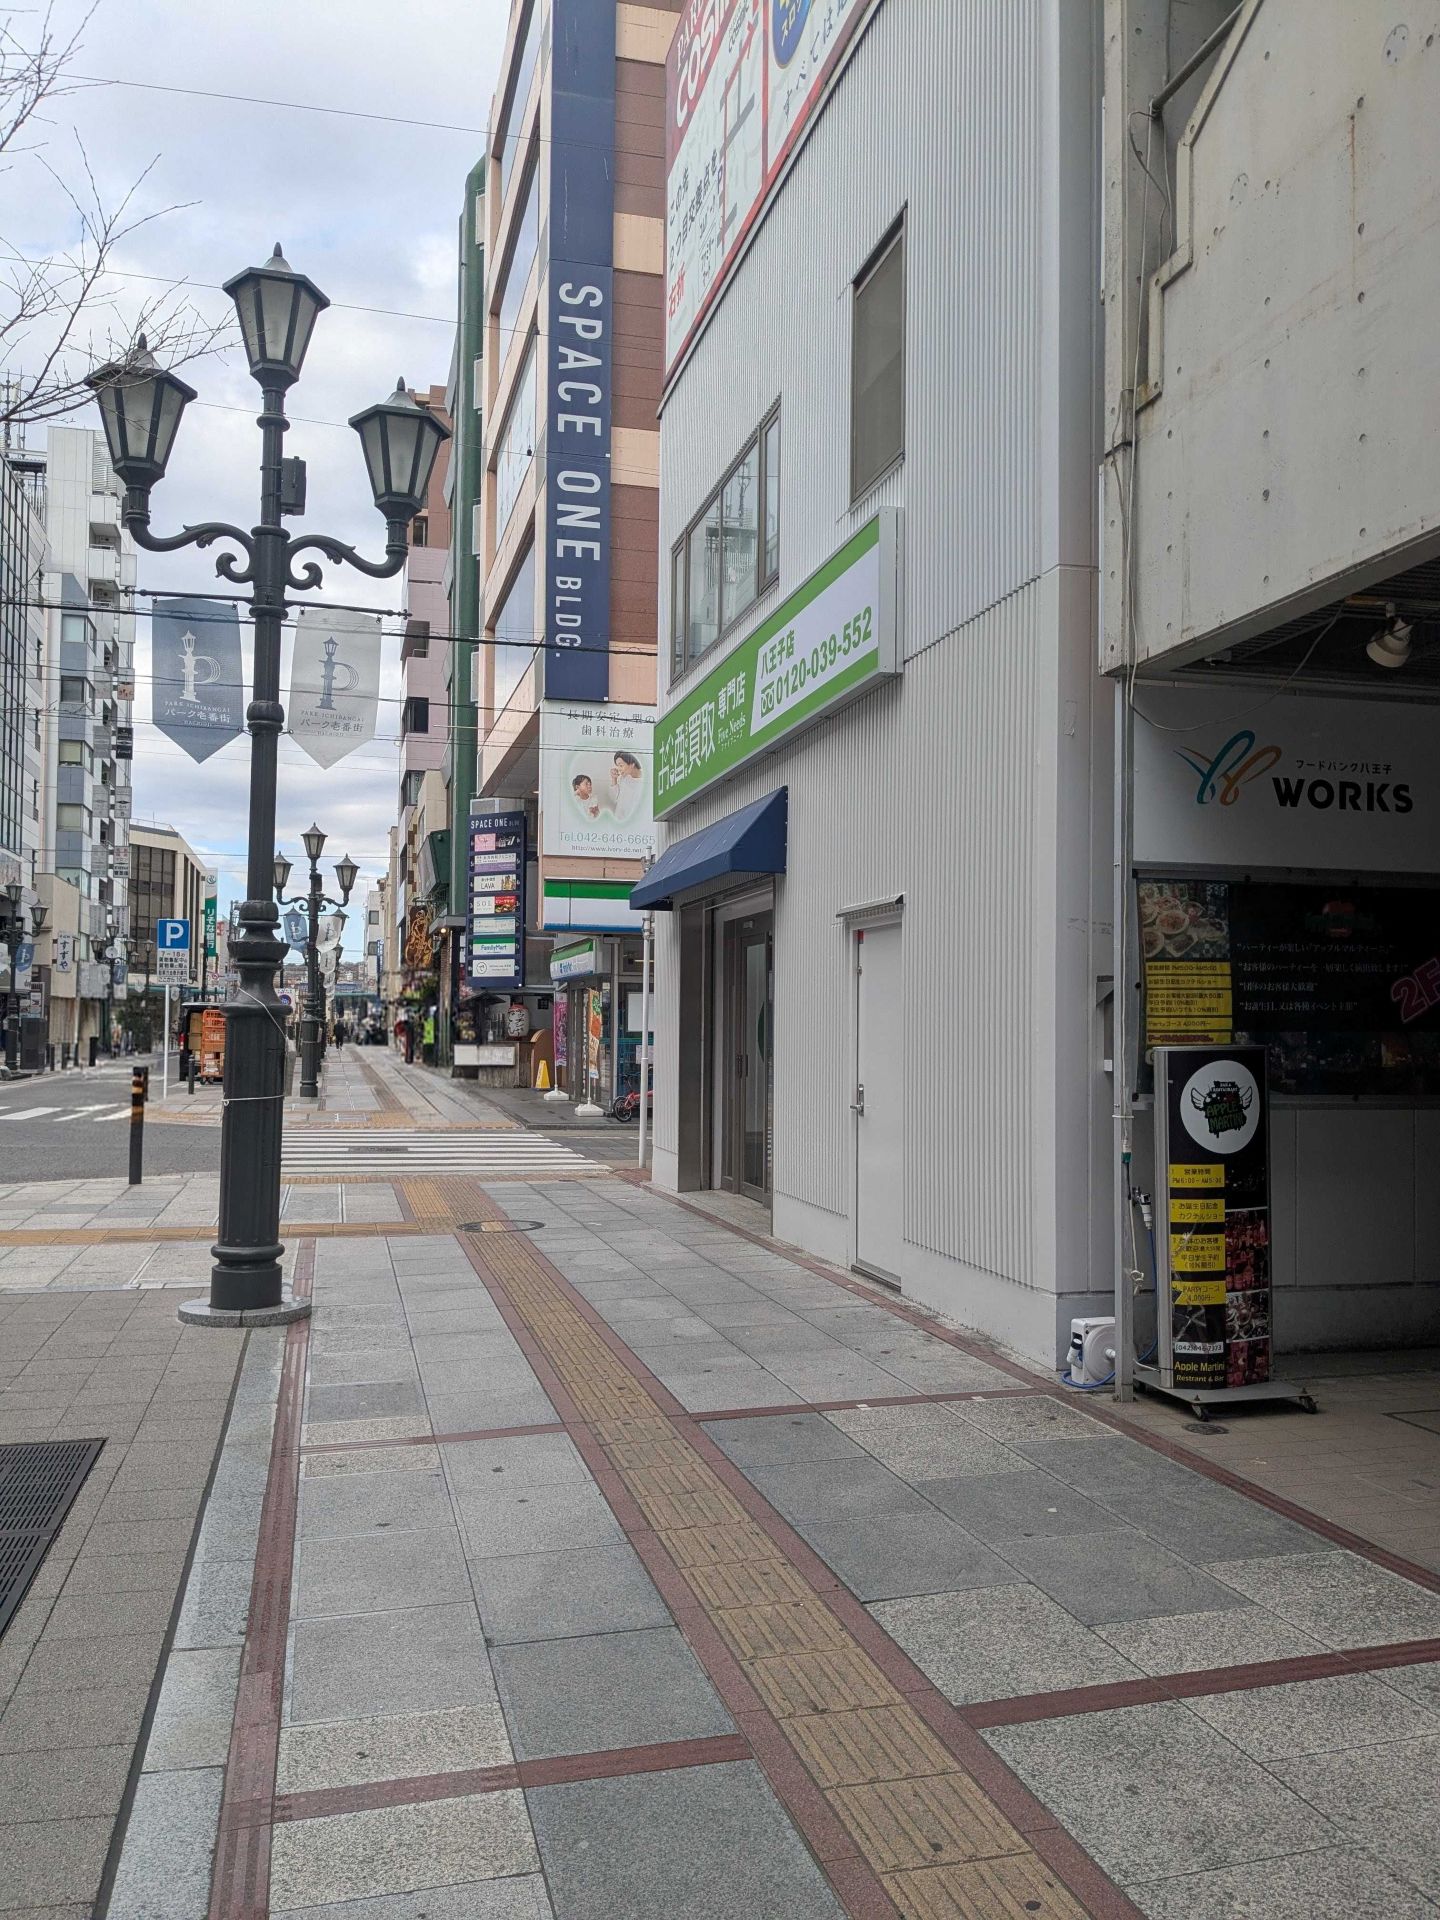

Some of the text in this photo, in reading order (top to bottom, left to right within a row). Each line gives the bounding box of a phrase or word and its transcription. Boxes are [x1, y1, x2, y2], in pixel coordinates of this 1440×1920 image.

[558, 282, 604, 437] SPACE
[556, 470, 601, 561] ONE
[761, 629, 795, 680] 八王子店
[776, 606, 872, 705] 0120-039-552
[719, 671, 746, 720] 専門店
[581, 724, 634, 738] 歯科治療
[1296, 760, 1392, 775] フードバンク八王子
[1272, 777, 1413, 814] WORKS
[470, 818, 492, 830] SPACE
[494, 817, 508, 828] ONE
[480, 882, 495, 890] LAVA
[166, 922, 184, 946] P
[1206, 1101, 1241, 1117] APPLE
[1174, 1361, 1199, 1371] Apple
